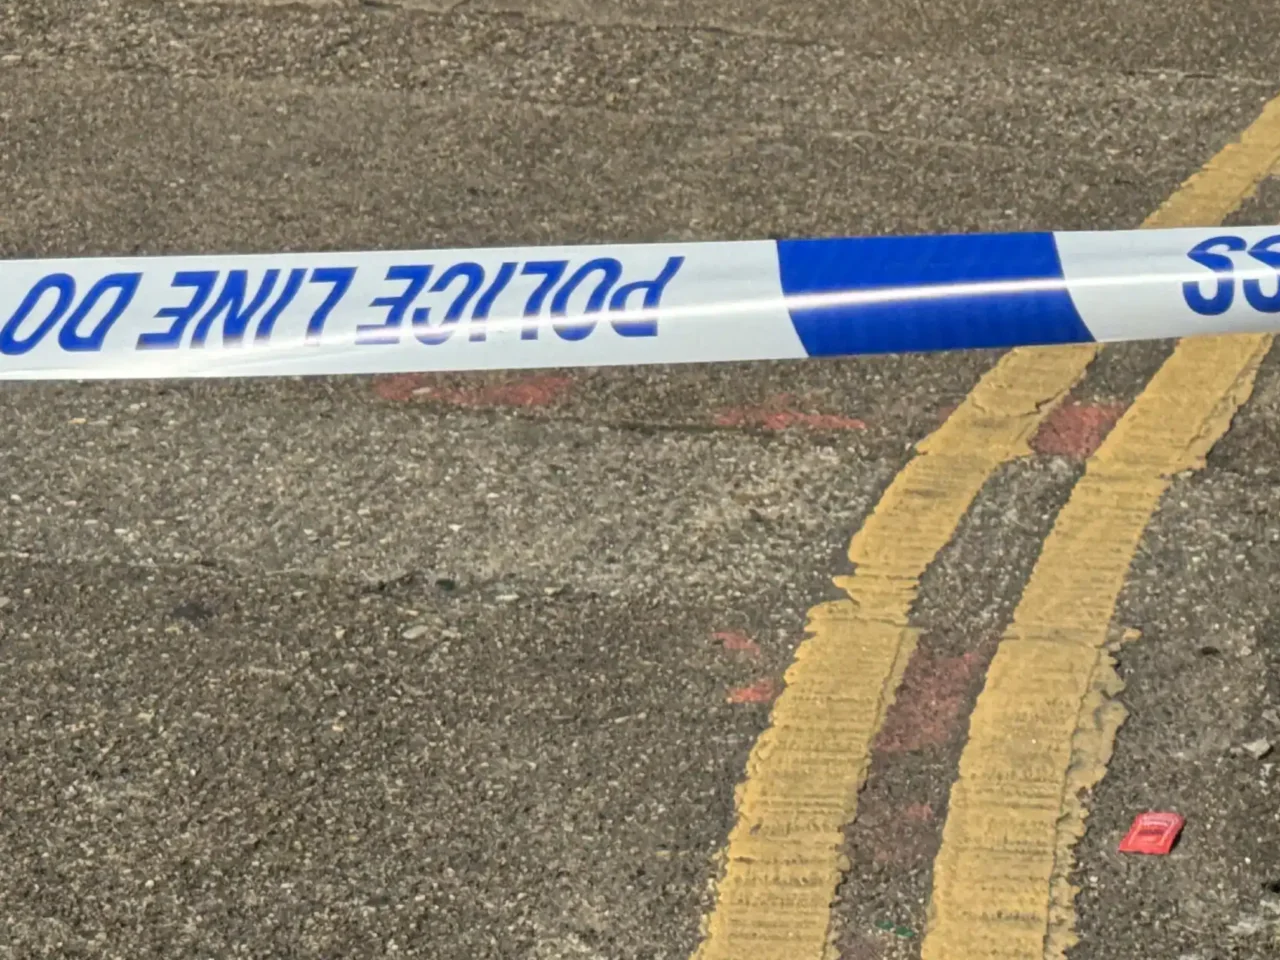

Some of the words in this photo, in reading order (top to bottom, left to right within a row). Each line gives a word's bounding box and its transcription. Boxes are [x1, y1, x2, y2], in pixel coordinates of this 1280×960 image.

[0, 271, 144, 355] DO
[136, 267, 357, 351] LINE
[356, 256, 686, 345] POLICE
